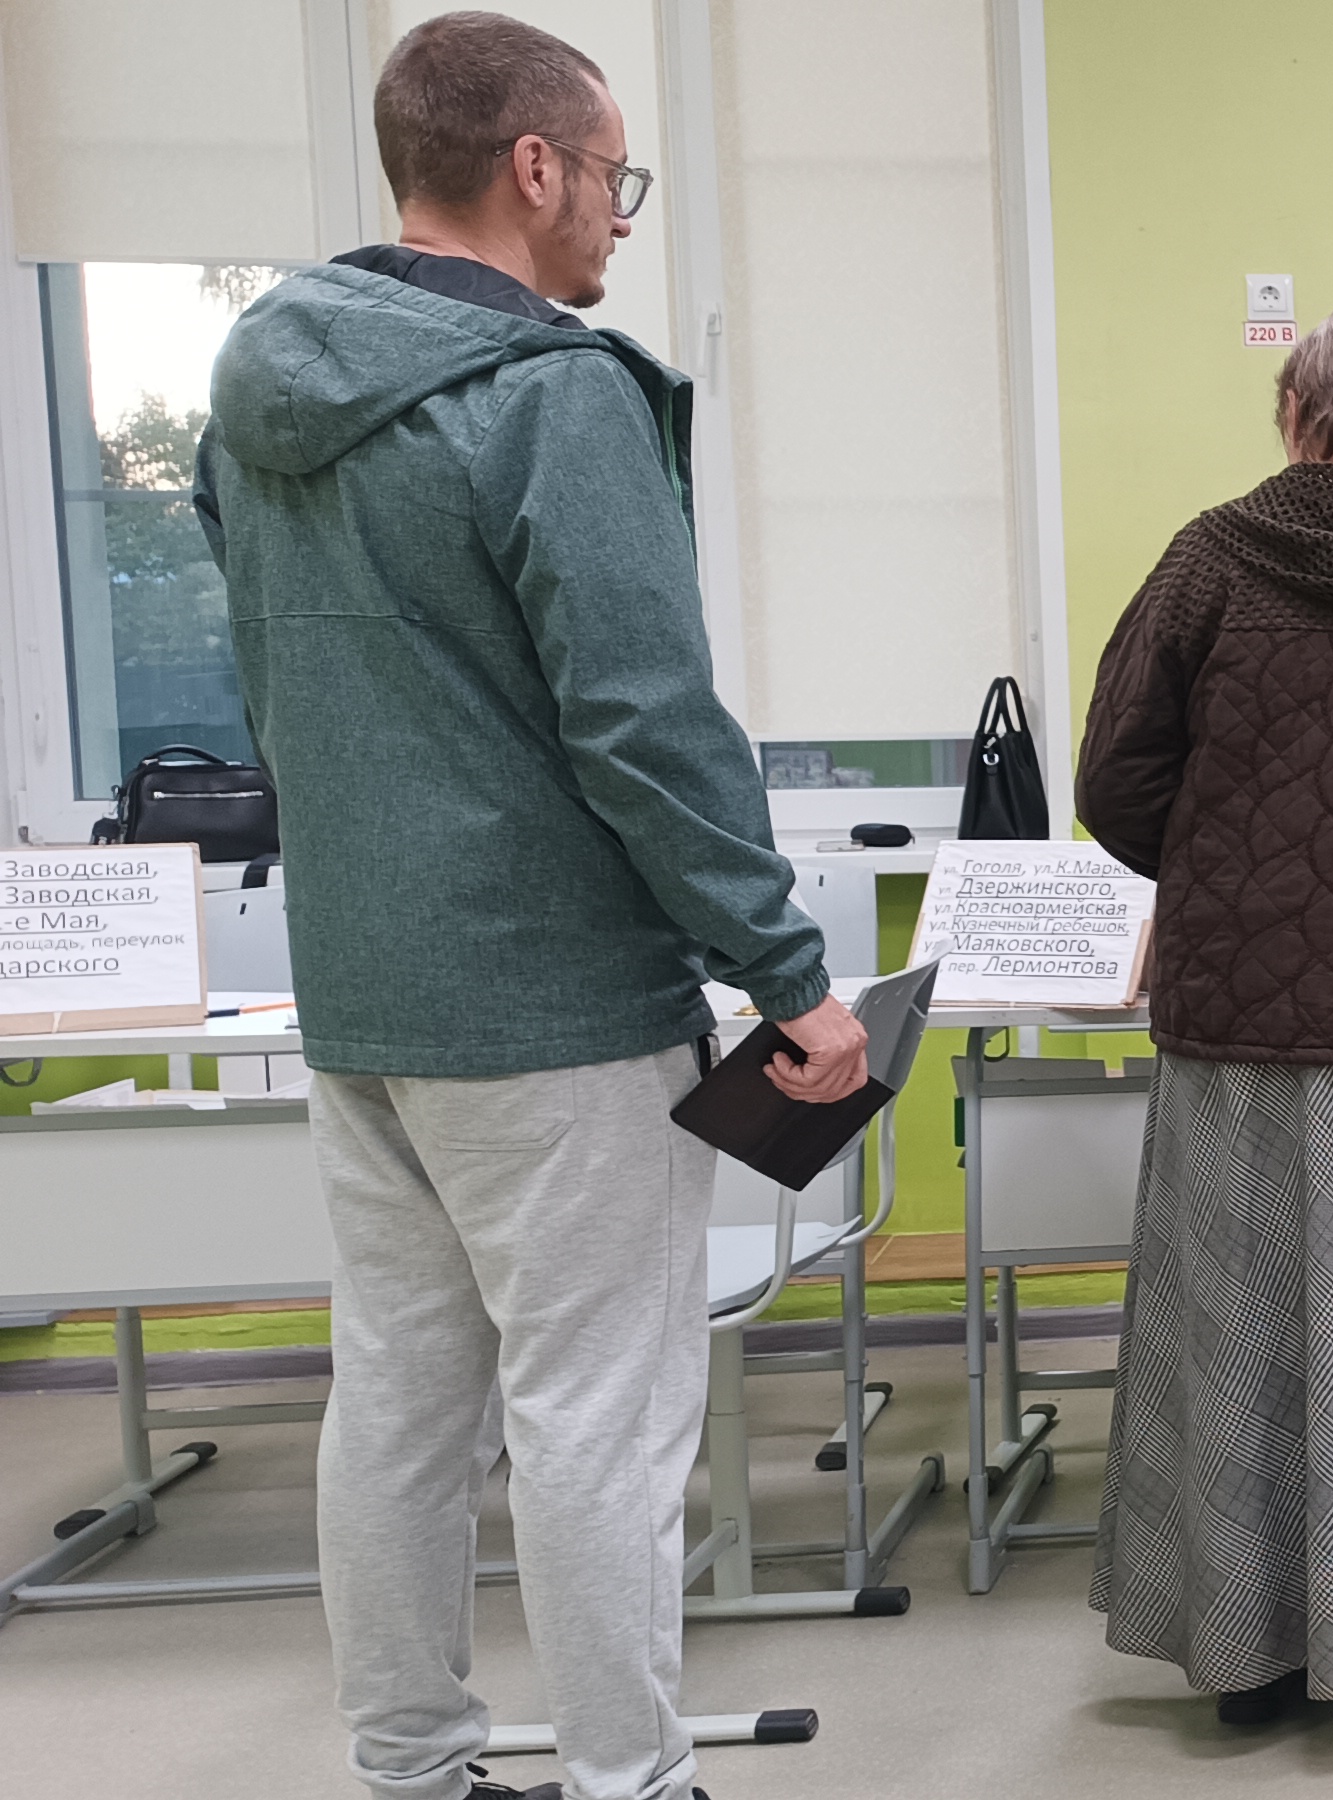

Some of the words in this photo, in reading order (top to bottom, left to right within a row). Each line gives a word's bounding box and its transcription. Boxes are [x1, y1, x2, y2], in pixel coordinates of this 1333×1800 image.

[1249, 327, 1276, 341] 220
[1282, 327, 1293, 341] В
[4, 860, 159, 879] Заводская,
[963, 860, 1027, 876] Гоголя,
[5, 886, 159, 905] Заводская,
[957, 878, 1117, 899] Дзержинского,
[41, 912, 108, 931] Мая,
[1045, 918, 1130, 935] Гребешок,
[0, 939, 85, 952] лощадь,
[92, 934, 185, 949] переулок
[953, 934, 1095, 956] Маяковского,
[948, 962, 979, 975] пер.
[982, 955, 1119, 976] Лермонтова
